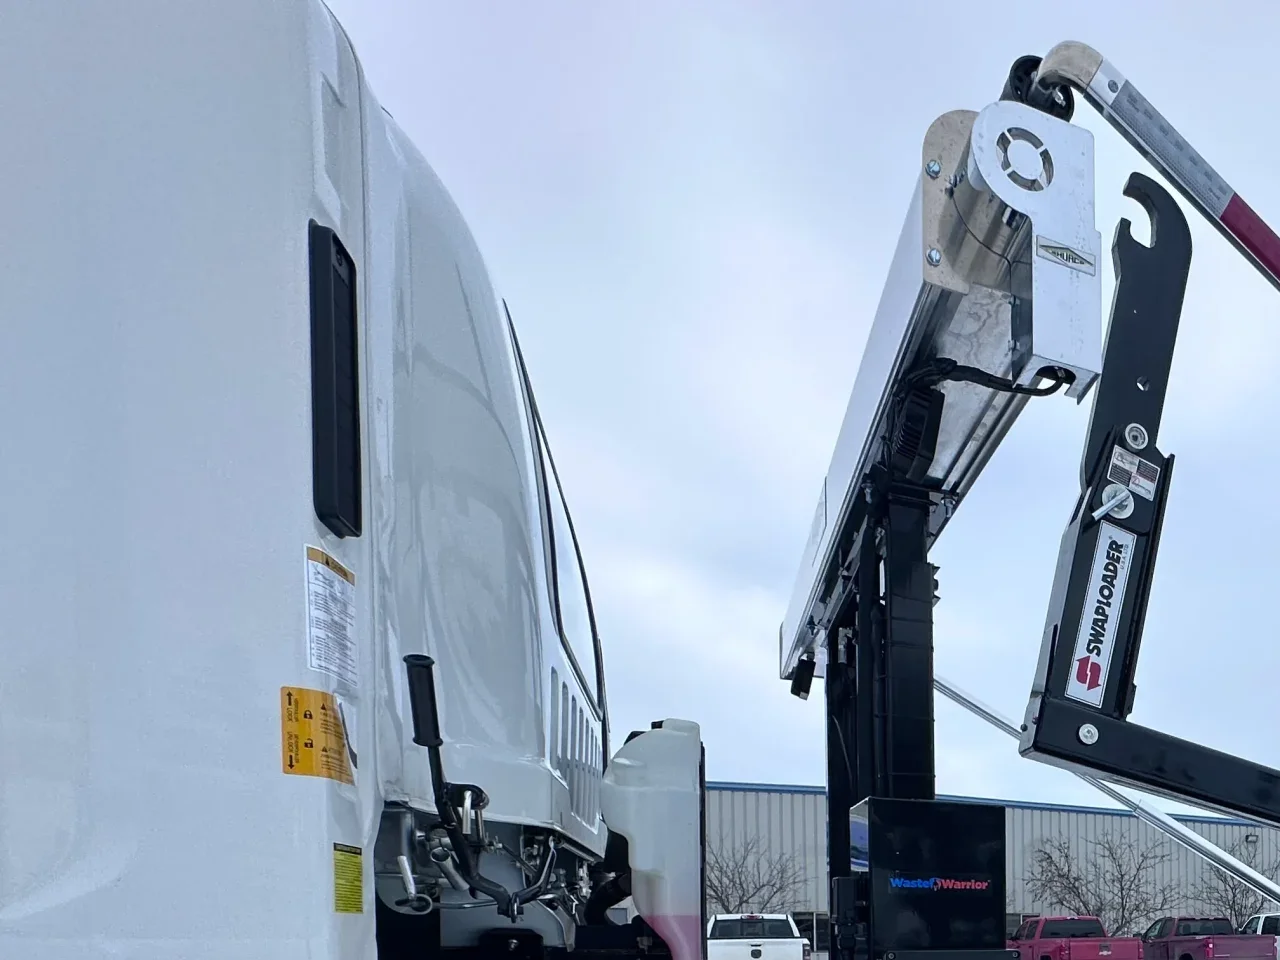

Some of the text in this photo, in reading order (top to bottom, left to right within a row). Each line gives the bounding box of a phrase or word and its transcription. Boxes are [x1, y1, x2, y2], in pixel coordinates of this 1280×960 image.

[1086, 539, 1125, 657] SWAPLOADER
[889, 877, 989, 890] Waste Warrior
